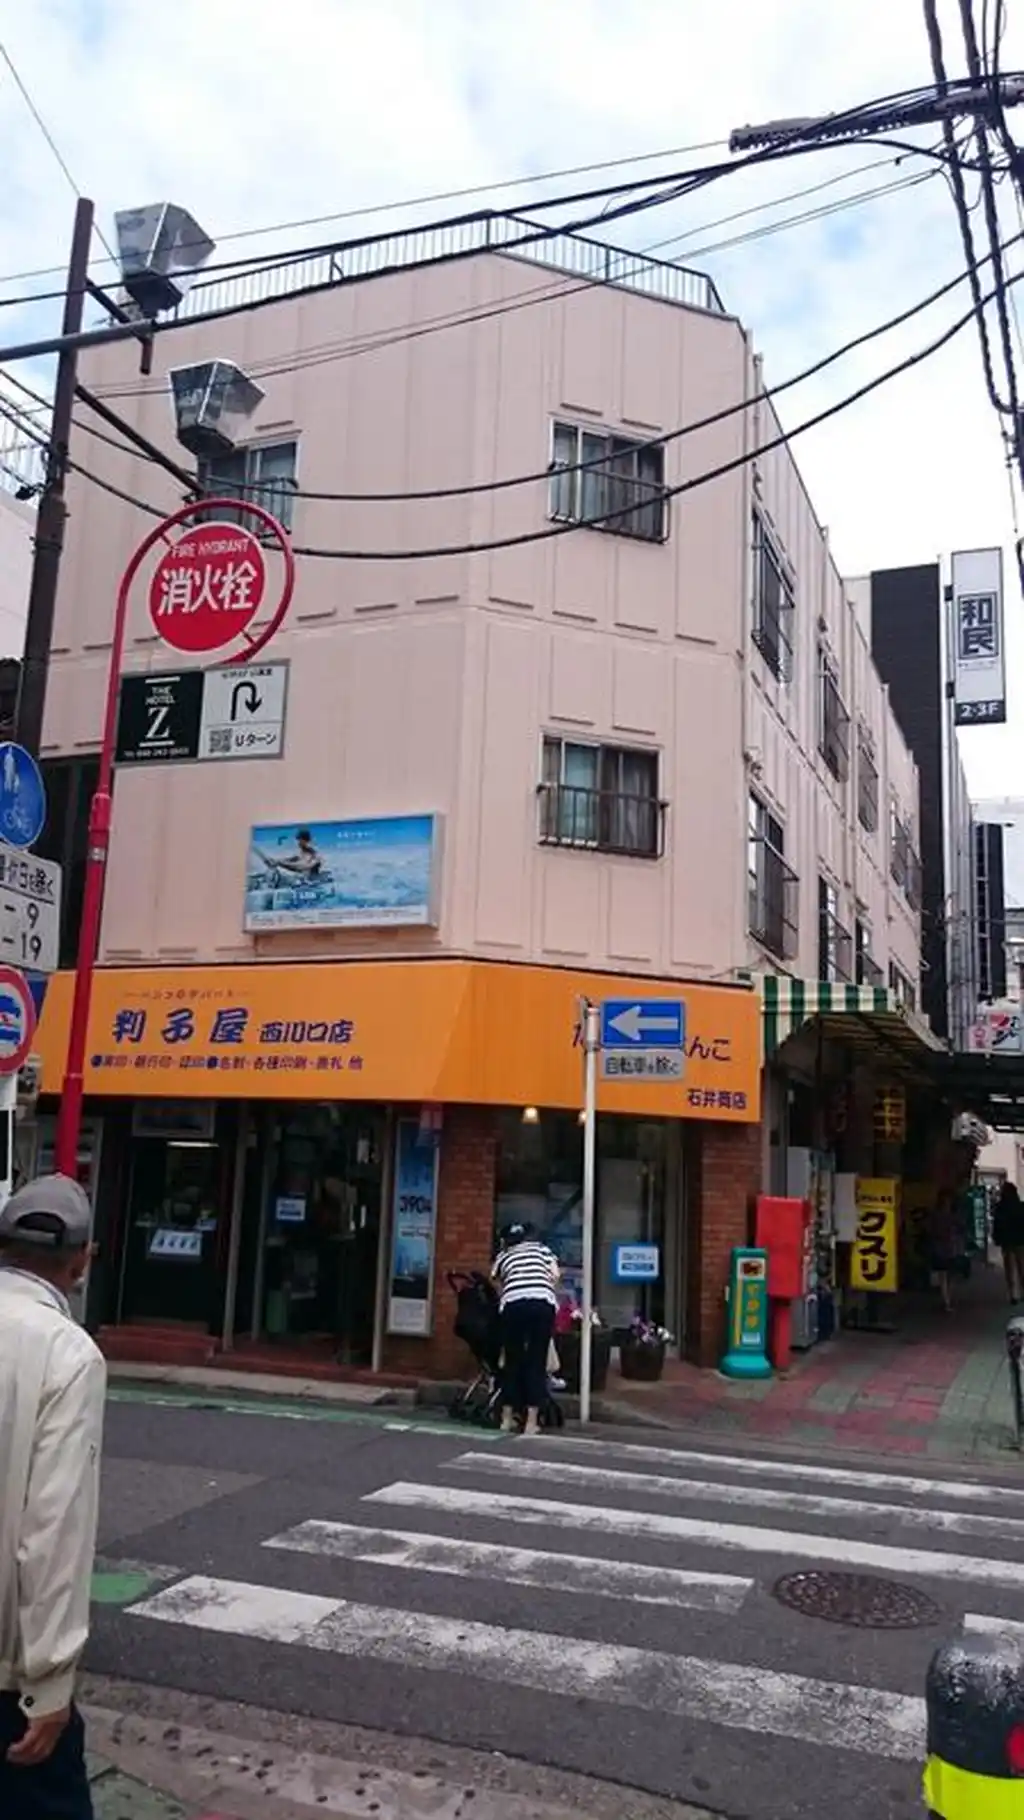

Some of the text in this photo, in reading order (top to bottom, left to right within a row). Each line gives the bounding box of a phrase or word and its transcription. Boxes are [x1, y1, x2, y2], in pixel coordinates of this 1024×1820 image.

[172, 537, 249, 558] FIRE HYDRANT
[157, 560, 257, 616] 消火栓
[962, 598, 994, 655] 和民
[152, 686, 171, 695] THE
[145, 707, 170, 740] Z
[235, 733, 277, 748] Uターン
[112, 1007, 354, 1043] 判子屋 西川口店
[605, 1056, 680, 1075] 自転車を除く
[687, 1088, 747, 1110] 石井商店
[860, 1211, 887, 1281] クスリ
